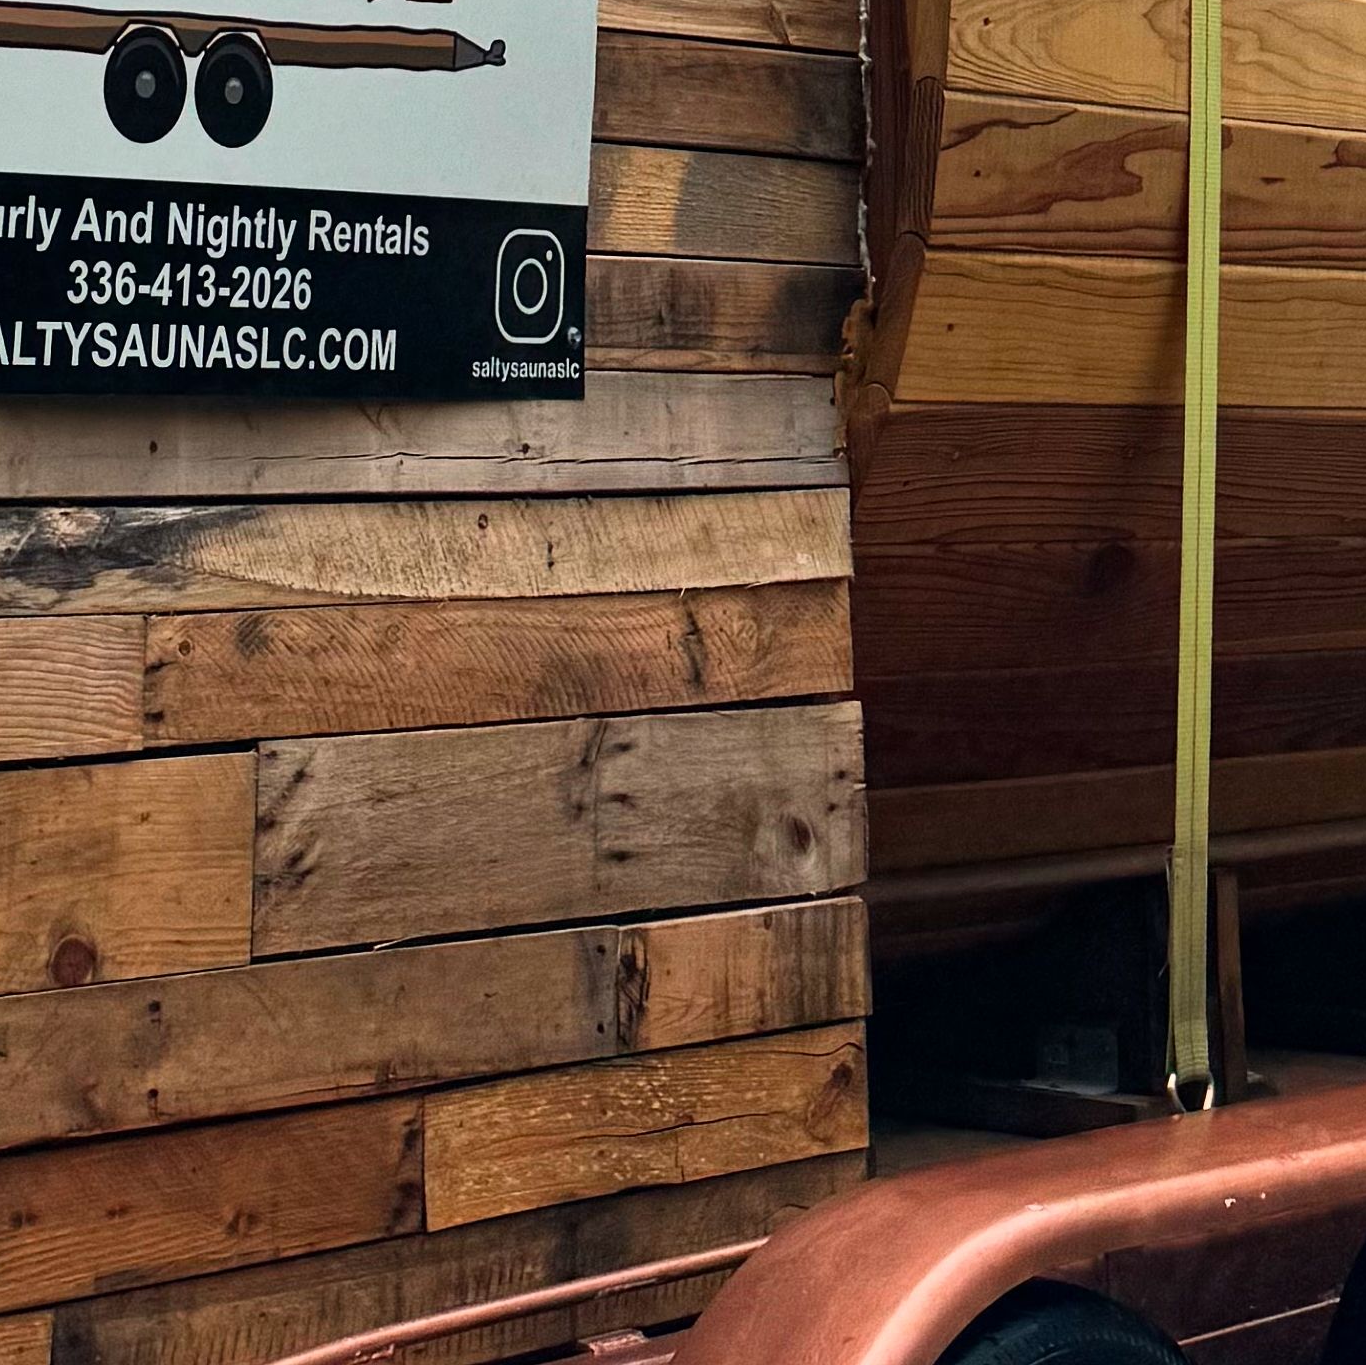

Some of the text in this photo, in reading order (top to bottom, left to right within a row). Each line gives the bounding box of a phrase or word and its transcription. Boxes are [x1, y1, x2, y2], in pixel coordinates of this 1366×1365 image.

[71, 197, 154, 246] And
[167, 201, 297, 262] Nightly
[308, 210, 430, 256] Rentals
[66, 259, 312, 311] 336-413-2026
[472, 356, 579, 382] saltysaunaslc
